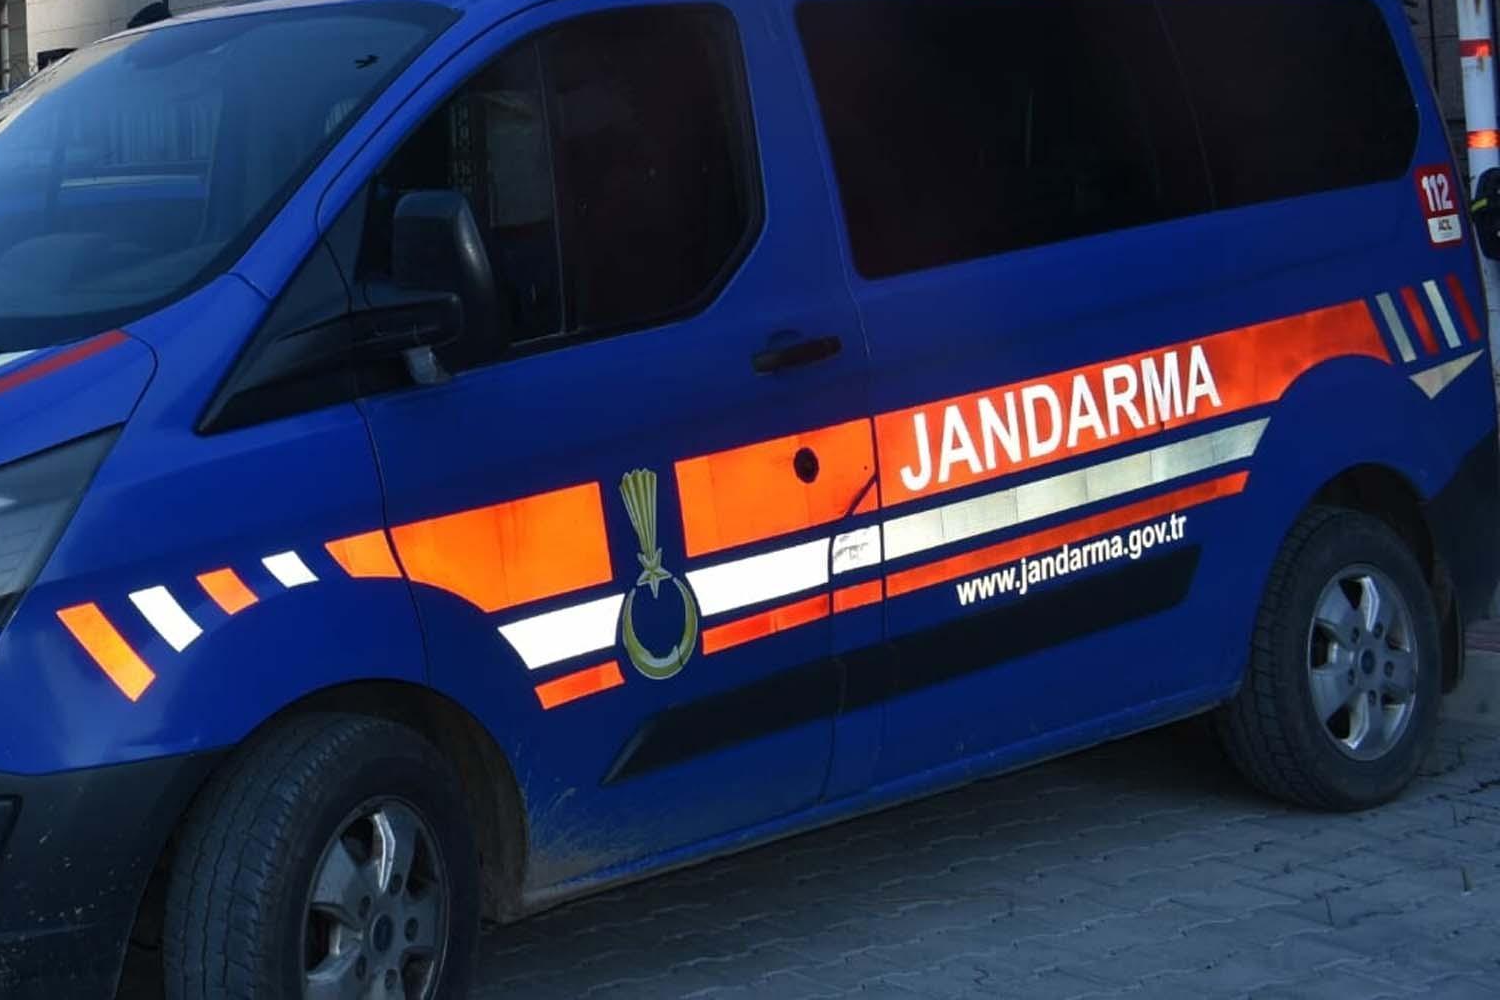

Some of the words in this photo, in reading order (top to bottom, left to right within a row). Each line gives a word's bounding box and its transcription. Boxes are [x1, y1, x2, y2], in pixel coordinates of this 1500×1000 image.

[1421, 173, 1454, 212] 112
[900, 344, 1223, 492] JANDARMA
[956, 513, 1188, 605] www.jandarma.gov.tr
